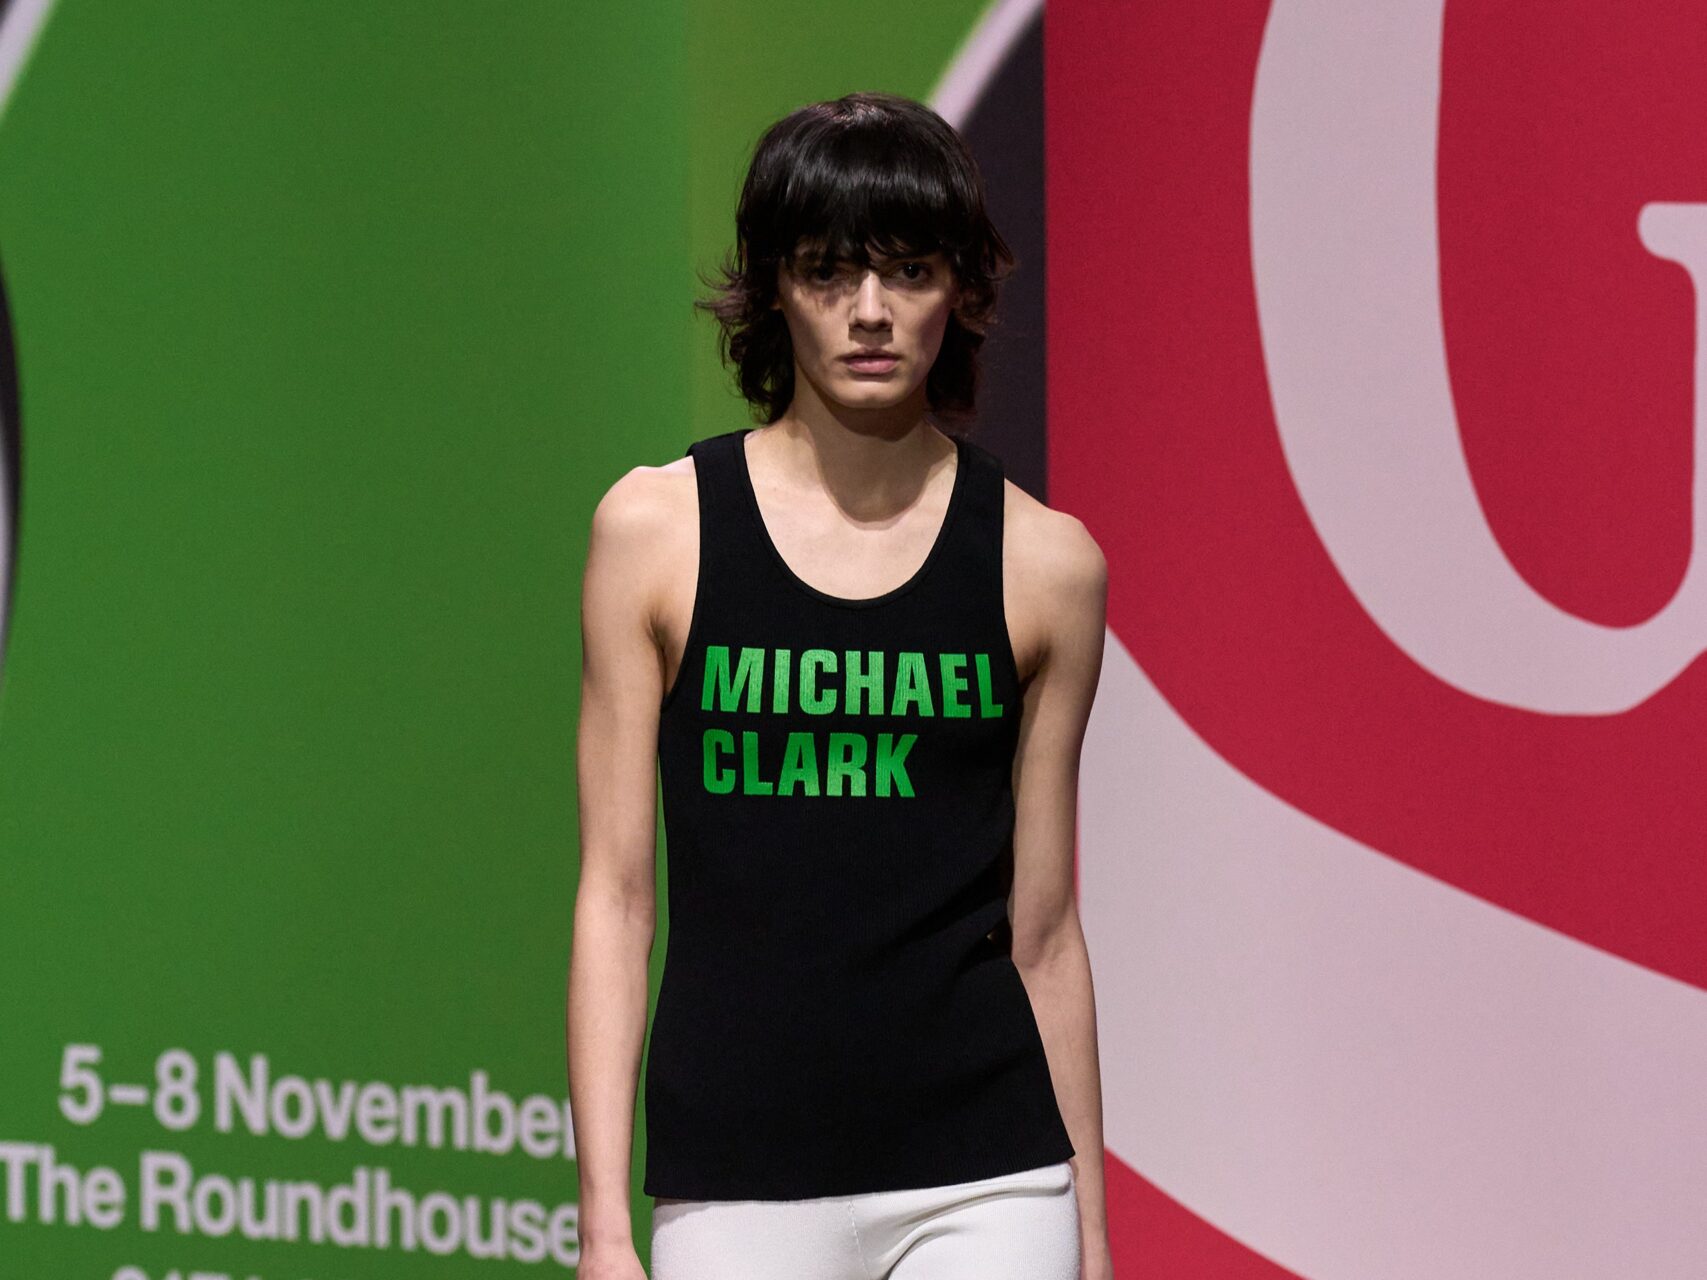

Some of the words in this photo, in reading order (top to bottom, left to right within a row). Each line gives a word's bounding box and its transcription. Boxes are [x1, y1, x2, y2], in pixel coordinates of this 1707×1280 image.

[701, 645, 1004, 719] MICHAEL
[703, 728, 919, 798] CLARK
[0, 1140, 126, 1229] The
[139, 1150, 579, 1267] Roundhouse
